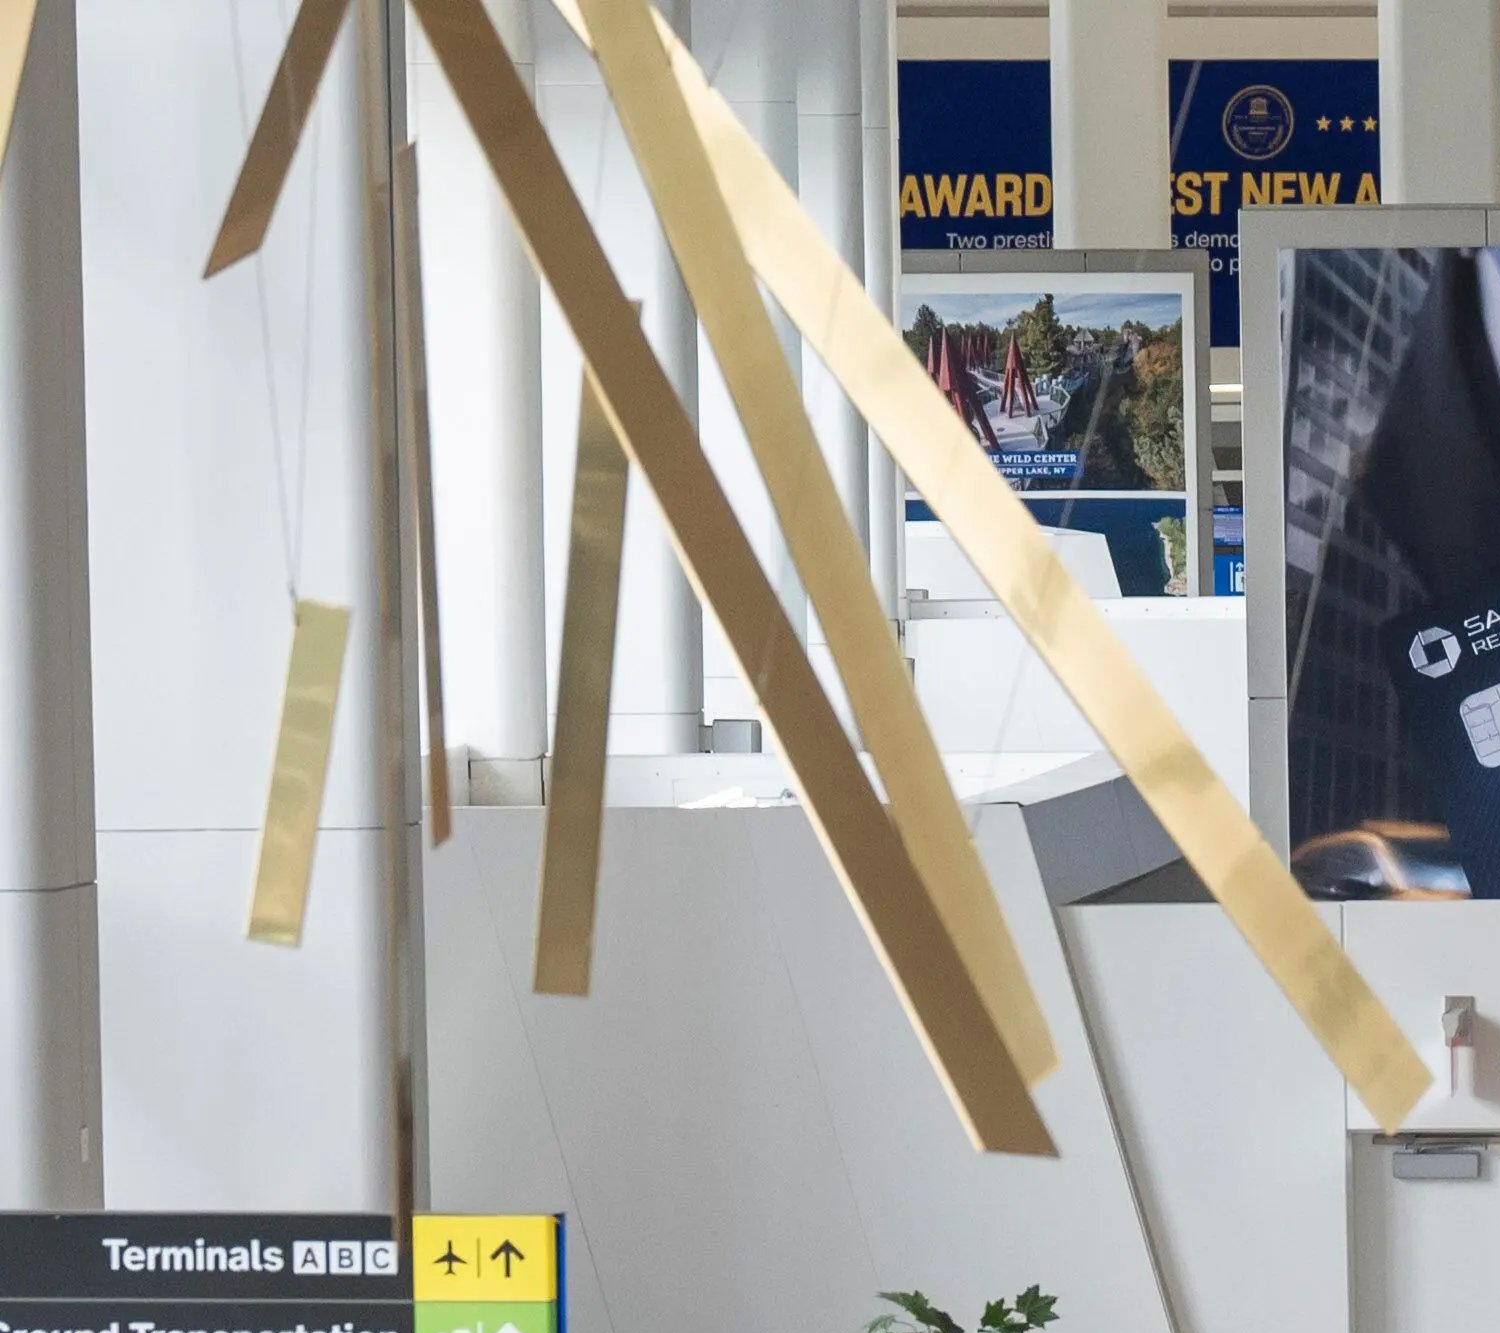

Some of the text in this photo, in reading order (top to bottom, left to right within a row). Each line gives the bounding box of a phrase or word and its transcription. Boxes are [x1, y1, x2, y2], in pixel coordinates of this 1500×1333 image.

[1242, 173, 1341, 205] NEW
[946, 232, 987, 249] Two
[1003, 454, 1032, 463] WILD
[1034, 453, 1077, 463] CENTER
[1053, 466, 1066, 476] NY
[101, 1237, 285, 1272] Terminals
